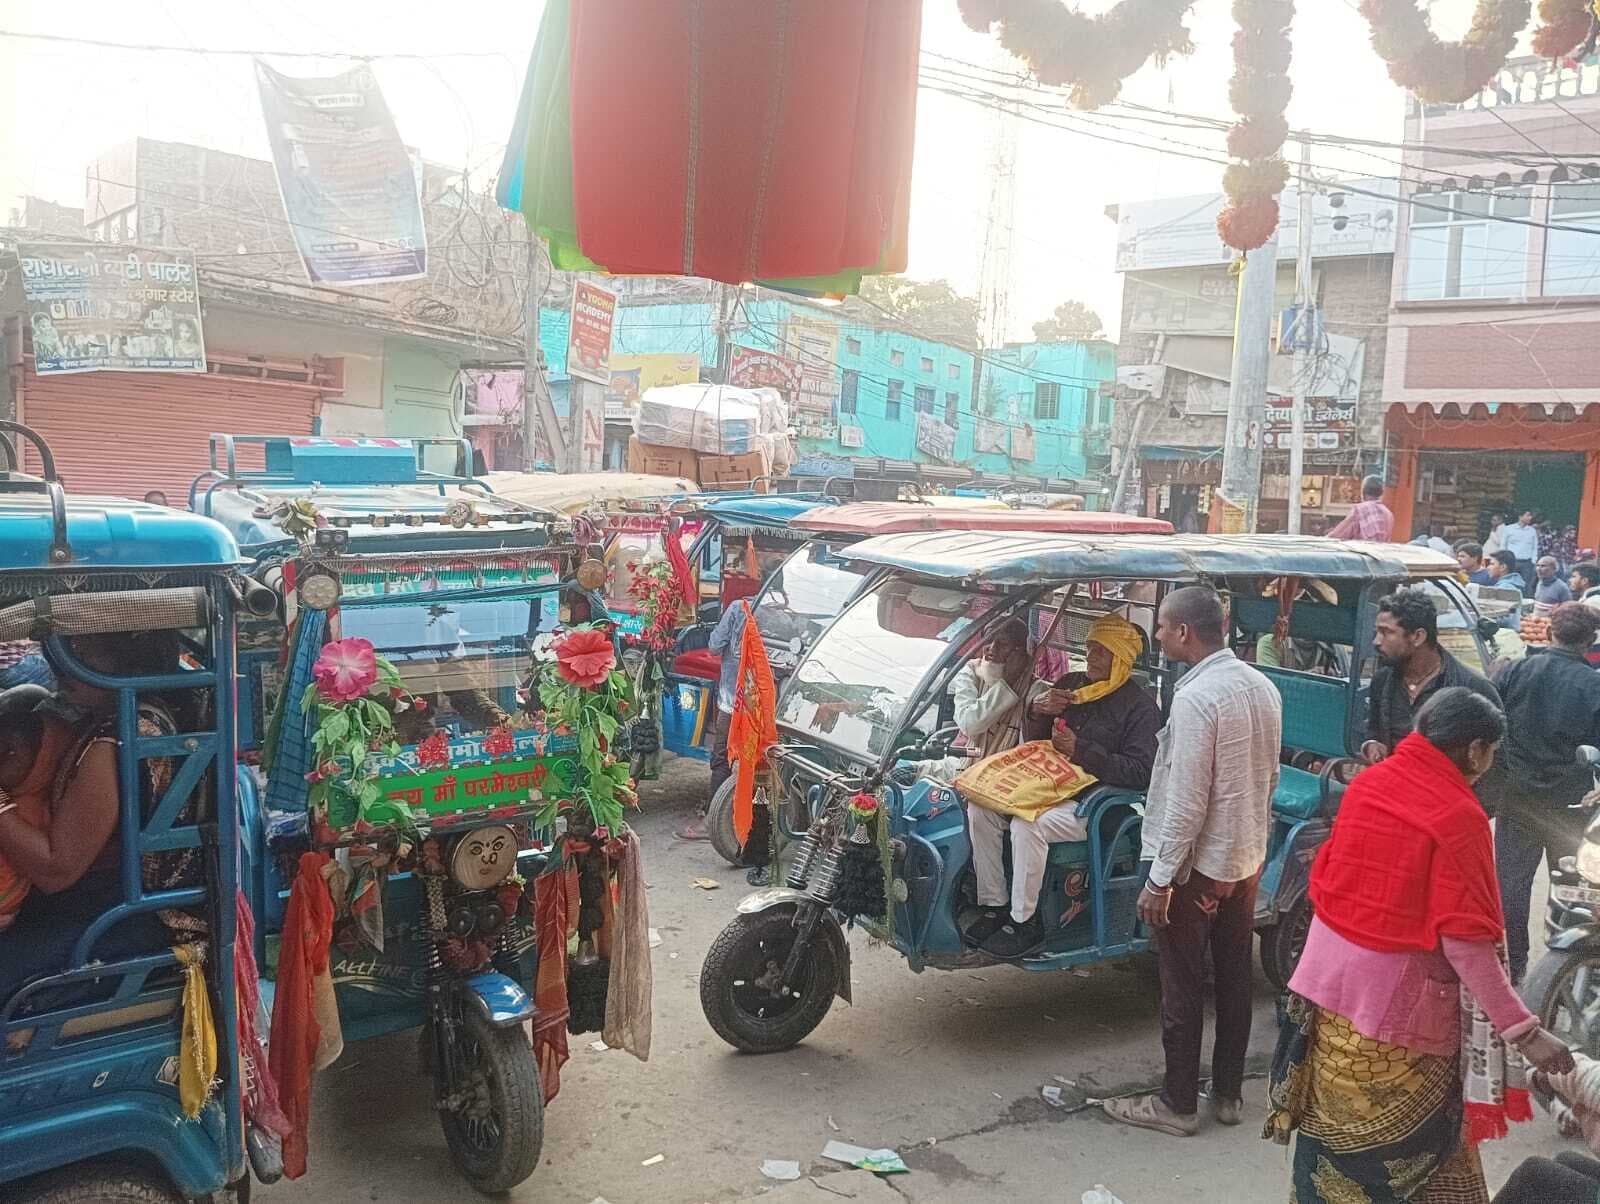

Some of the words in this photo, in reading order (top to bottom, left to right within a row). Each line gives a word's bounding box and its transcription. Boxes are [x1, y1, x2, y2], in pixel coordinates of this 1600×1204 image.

[575, 302, 612, 322] ACADEMY
[432, 775, 457, 803] माँ
[464, 763, 548, 797] परमेश्वरी
